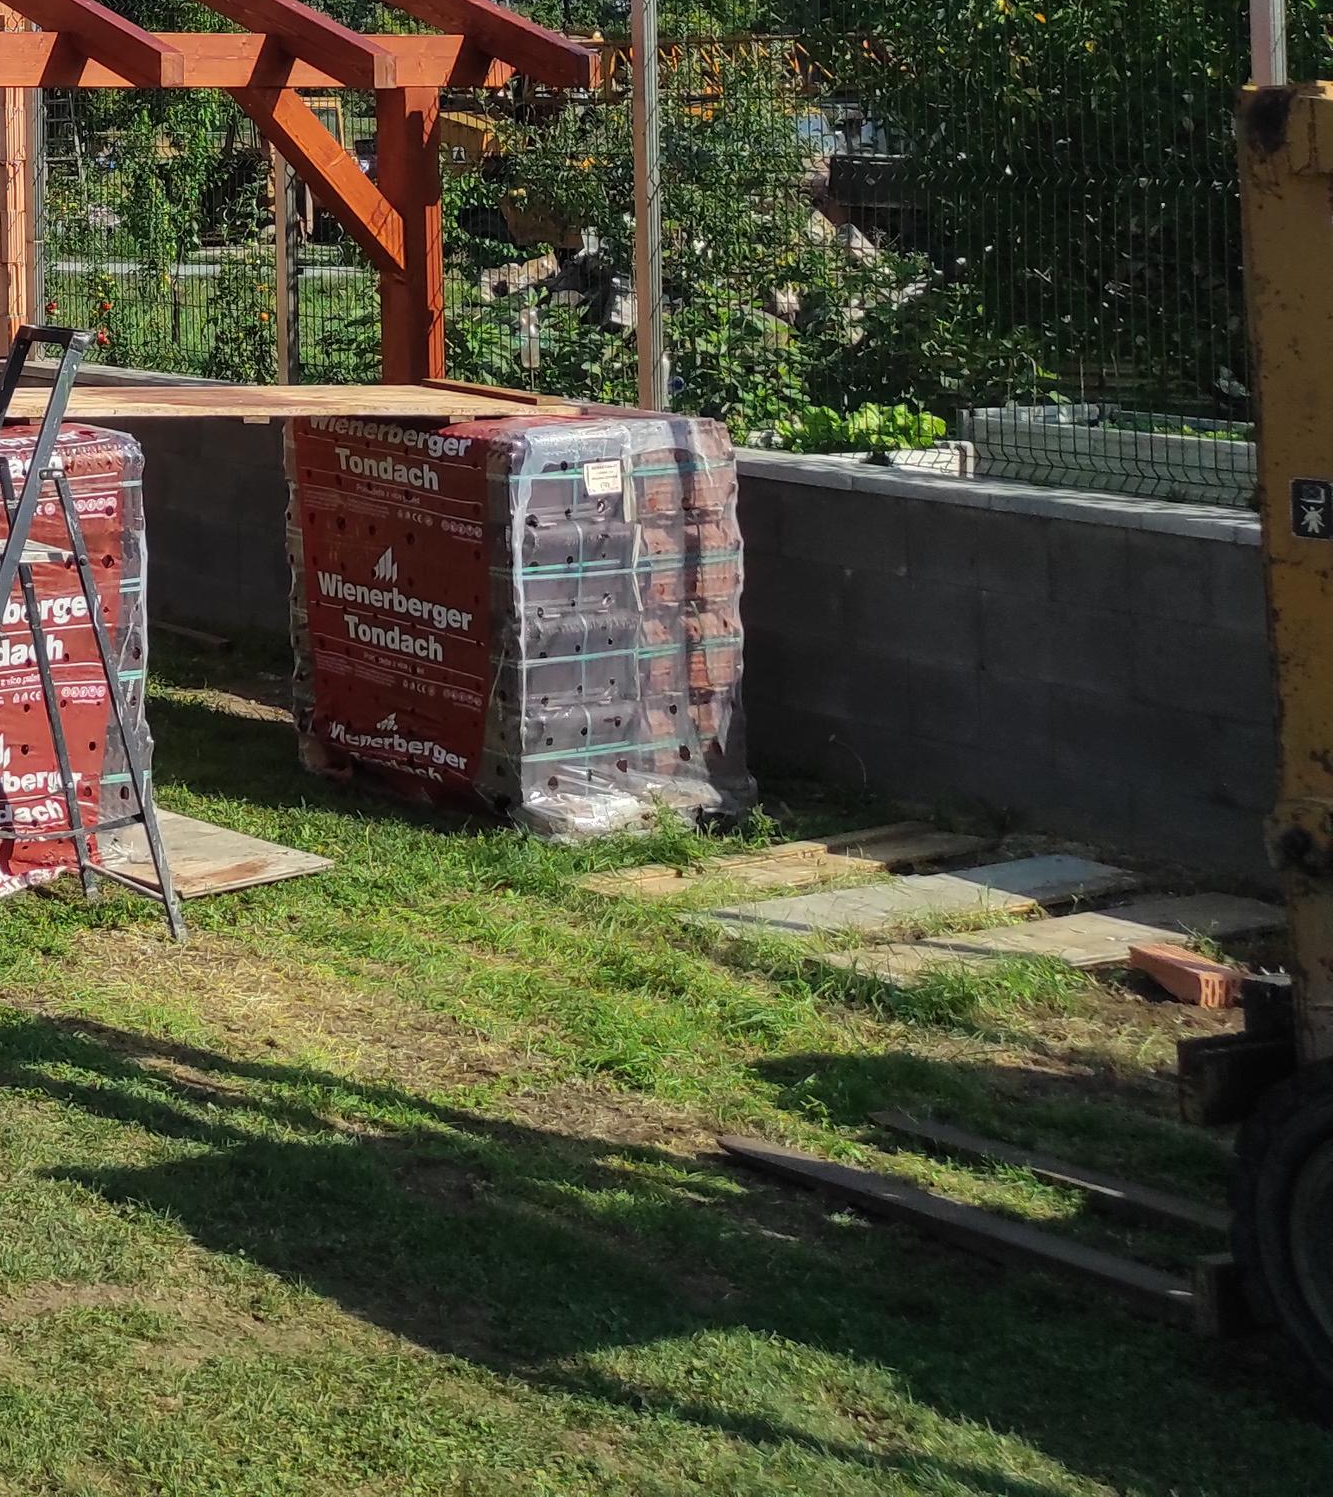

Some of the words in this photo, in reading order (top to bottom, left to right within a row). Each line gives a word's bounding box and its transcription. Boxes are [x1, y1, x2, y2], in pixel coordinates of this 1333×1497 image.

[335, 447, 439, 491] Tondach
[317, 570, 473, 632] Wienerberger
[344, 614, 443, 663] Tondach
